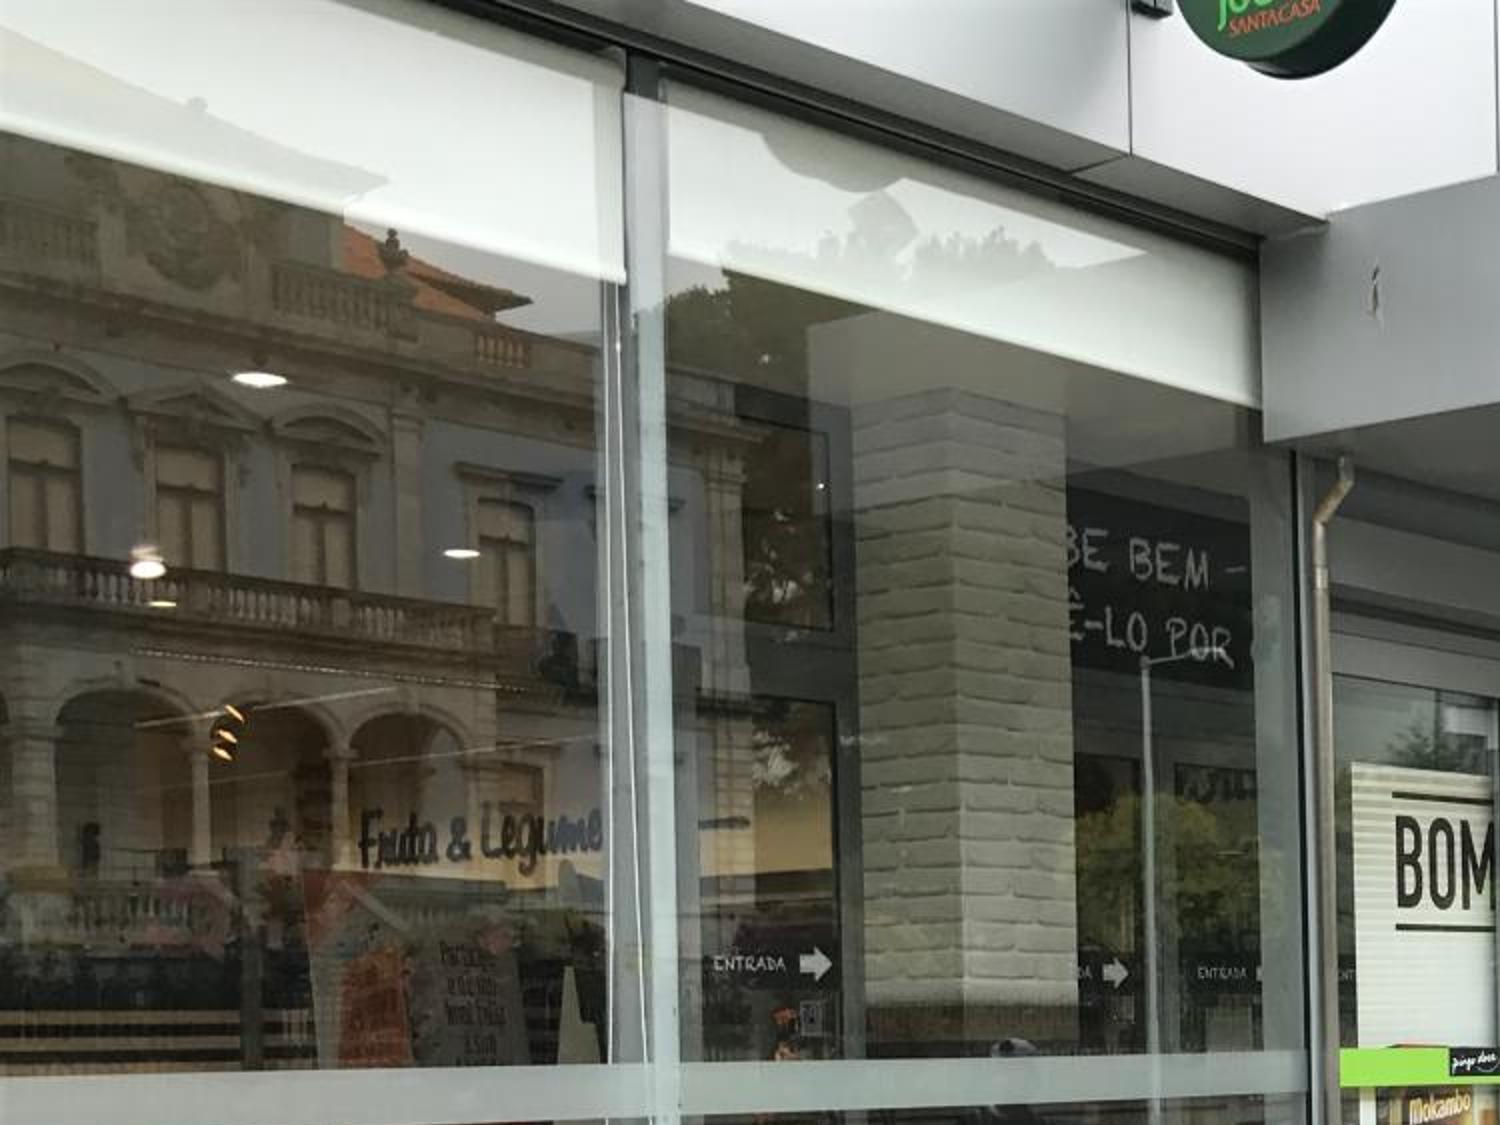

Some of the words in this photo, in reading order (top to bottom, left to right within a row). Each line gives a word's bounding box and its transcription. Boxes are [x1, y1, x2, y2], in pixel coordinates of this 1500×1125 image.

[1129, 537, 1209, 591] BEM
[1166, 616, 1235, 669] POR
[447, 815, 472, 863] &
[1395, 815, 1496, 911] BOM
[713, 953, 788, 972] ENTRADA
[1197, 966, 1247, 980] ENTRADA
